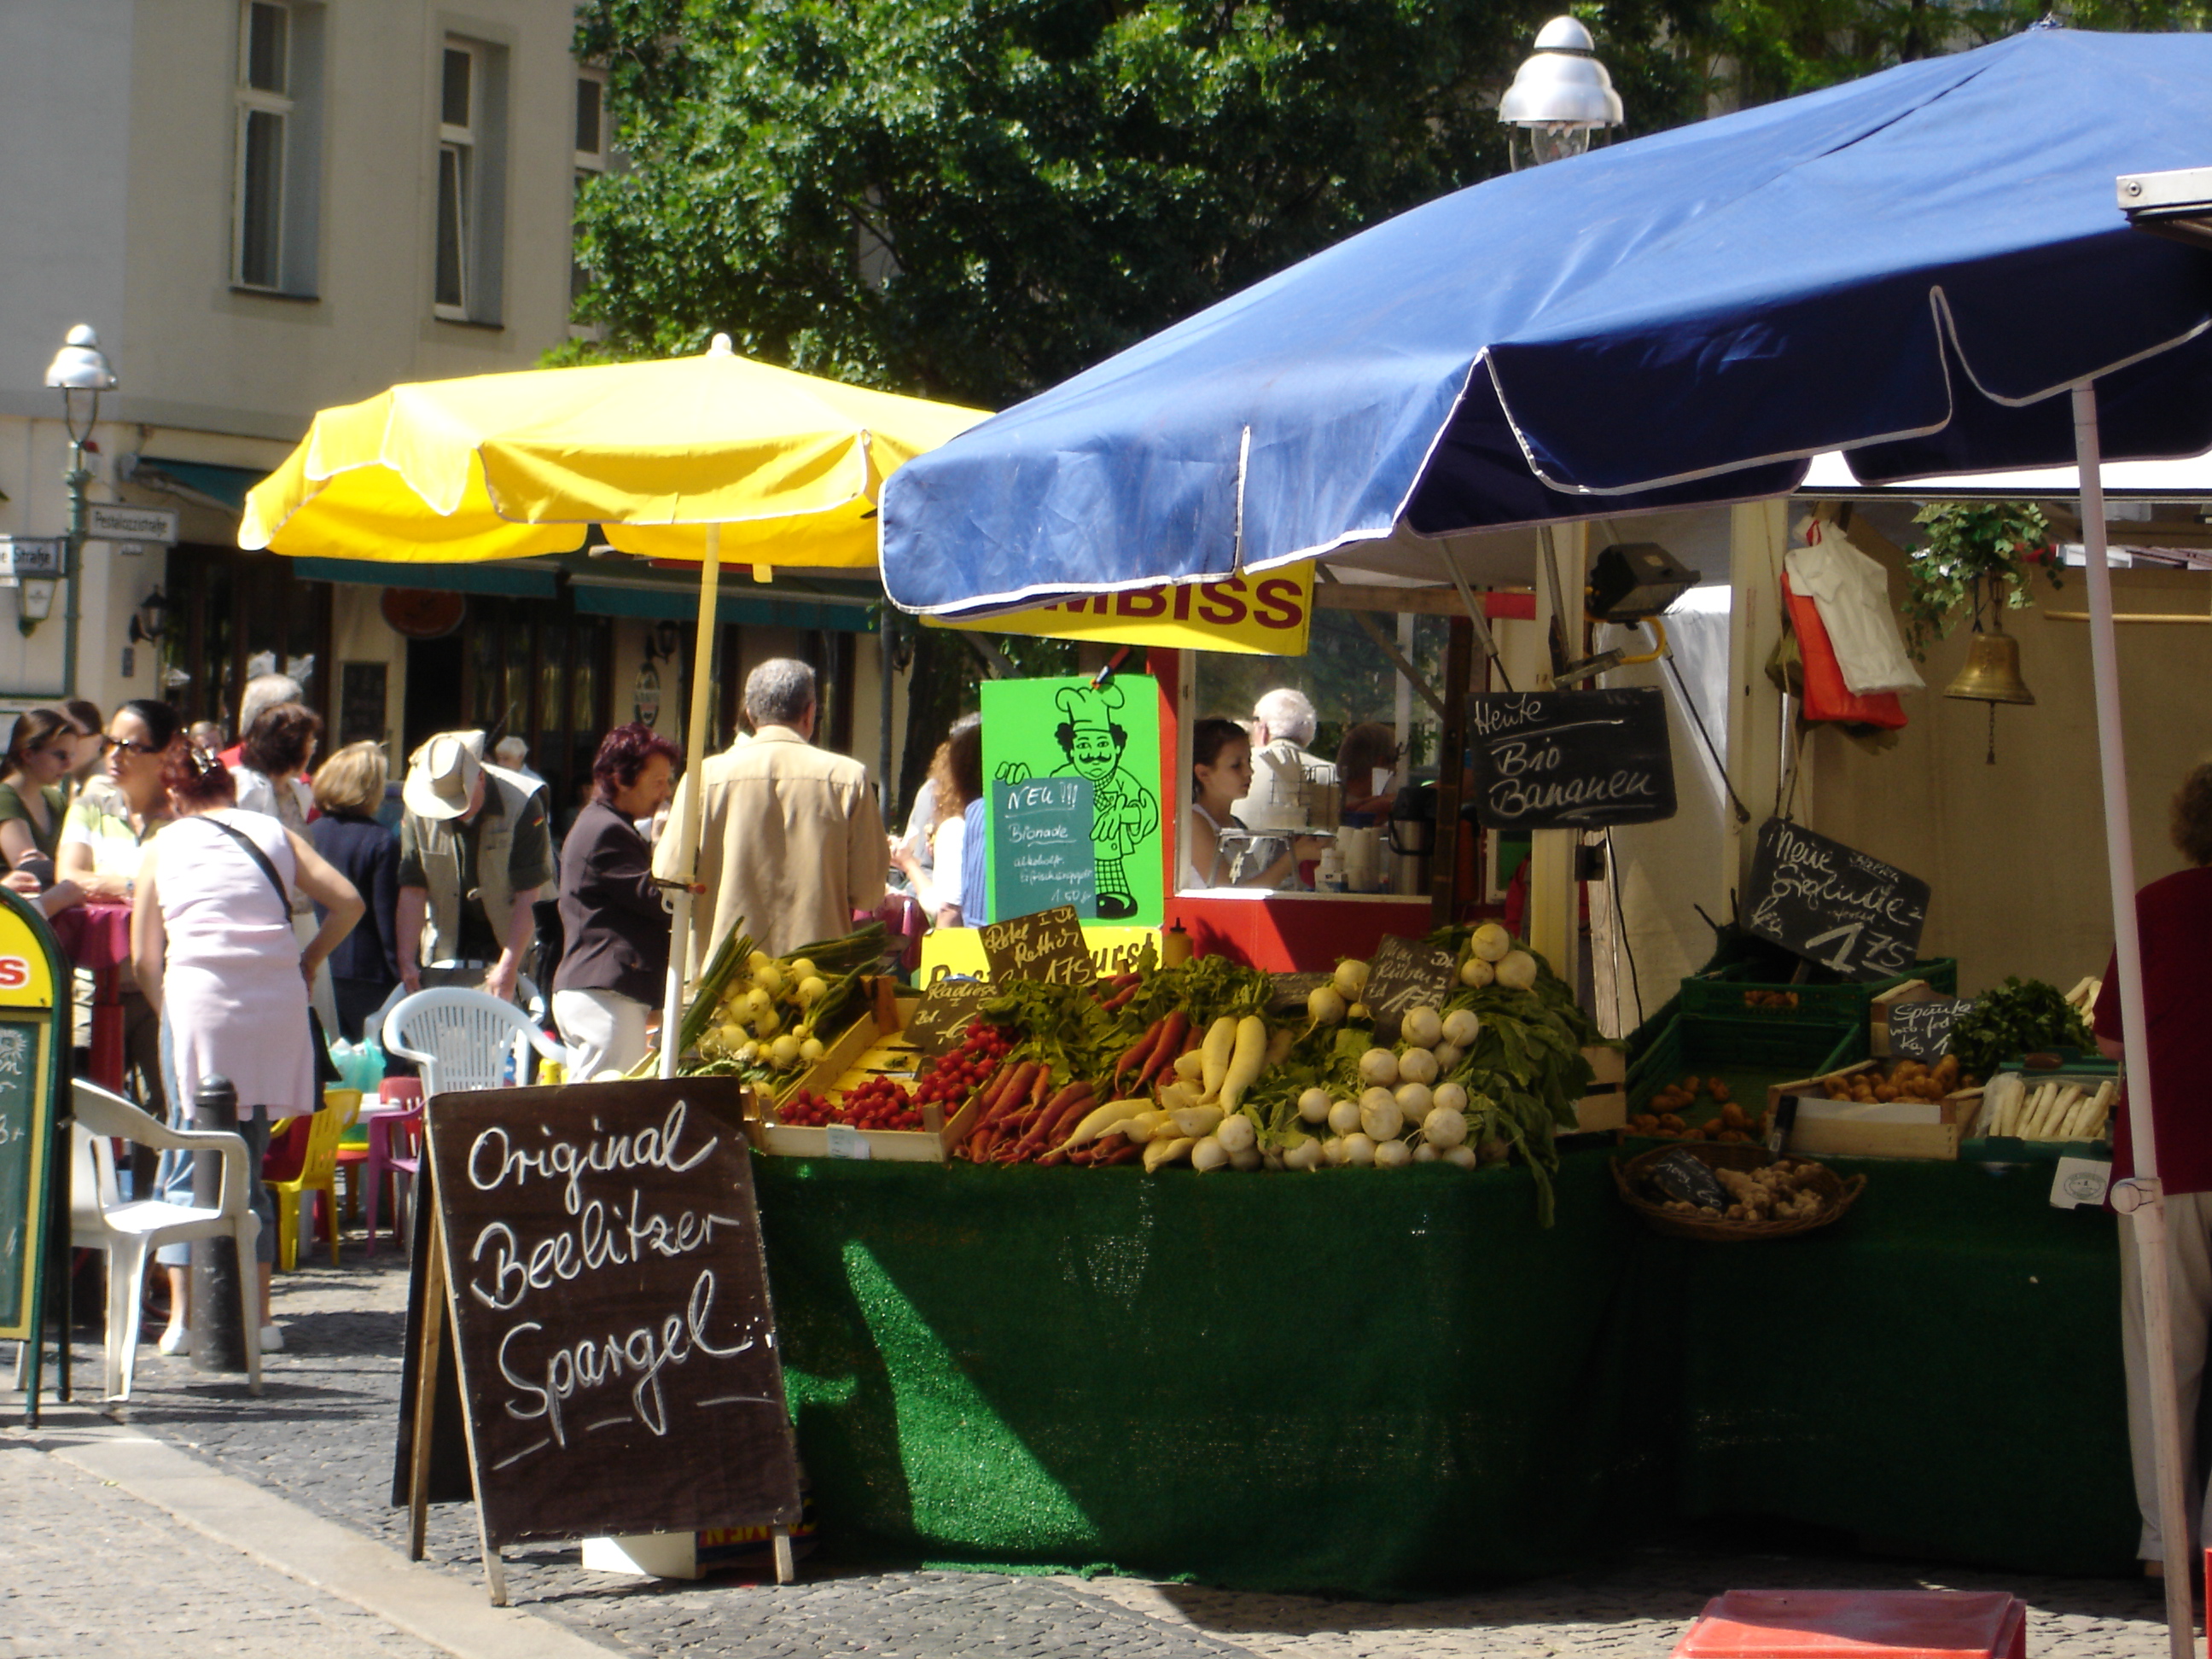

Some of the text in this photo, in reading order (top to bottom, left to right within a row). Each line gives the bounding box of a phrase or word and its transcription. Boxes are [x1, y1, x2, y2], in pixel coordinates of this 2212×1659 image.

[14, 547, 51, 568] Straße
[1475, 694, 1547, 736] Heute
[1491, 736, 1561, 777] Bio
[1489, 770, 1659, 818] Bananen
[1008, 824, 1068, 843] Bionade
[469, 1100, 719, 1216] Original
[471, 1188, 740, 1310] Beelitzer
[498, 1269, 754, 1449] Spargel
